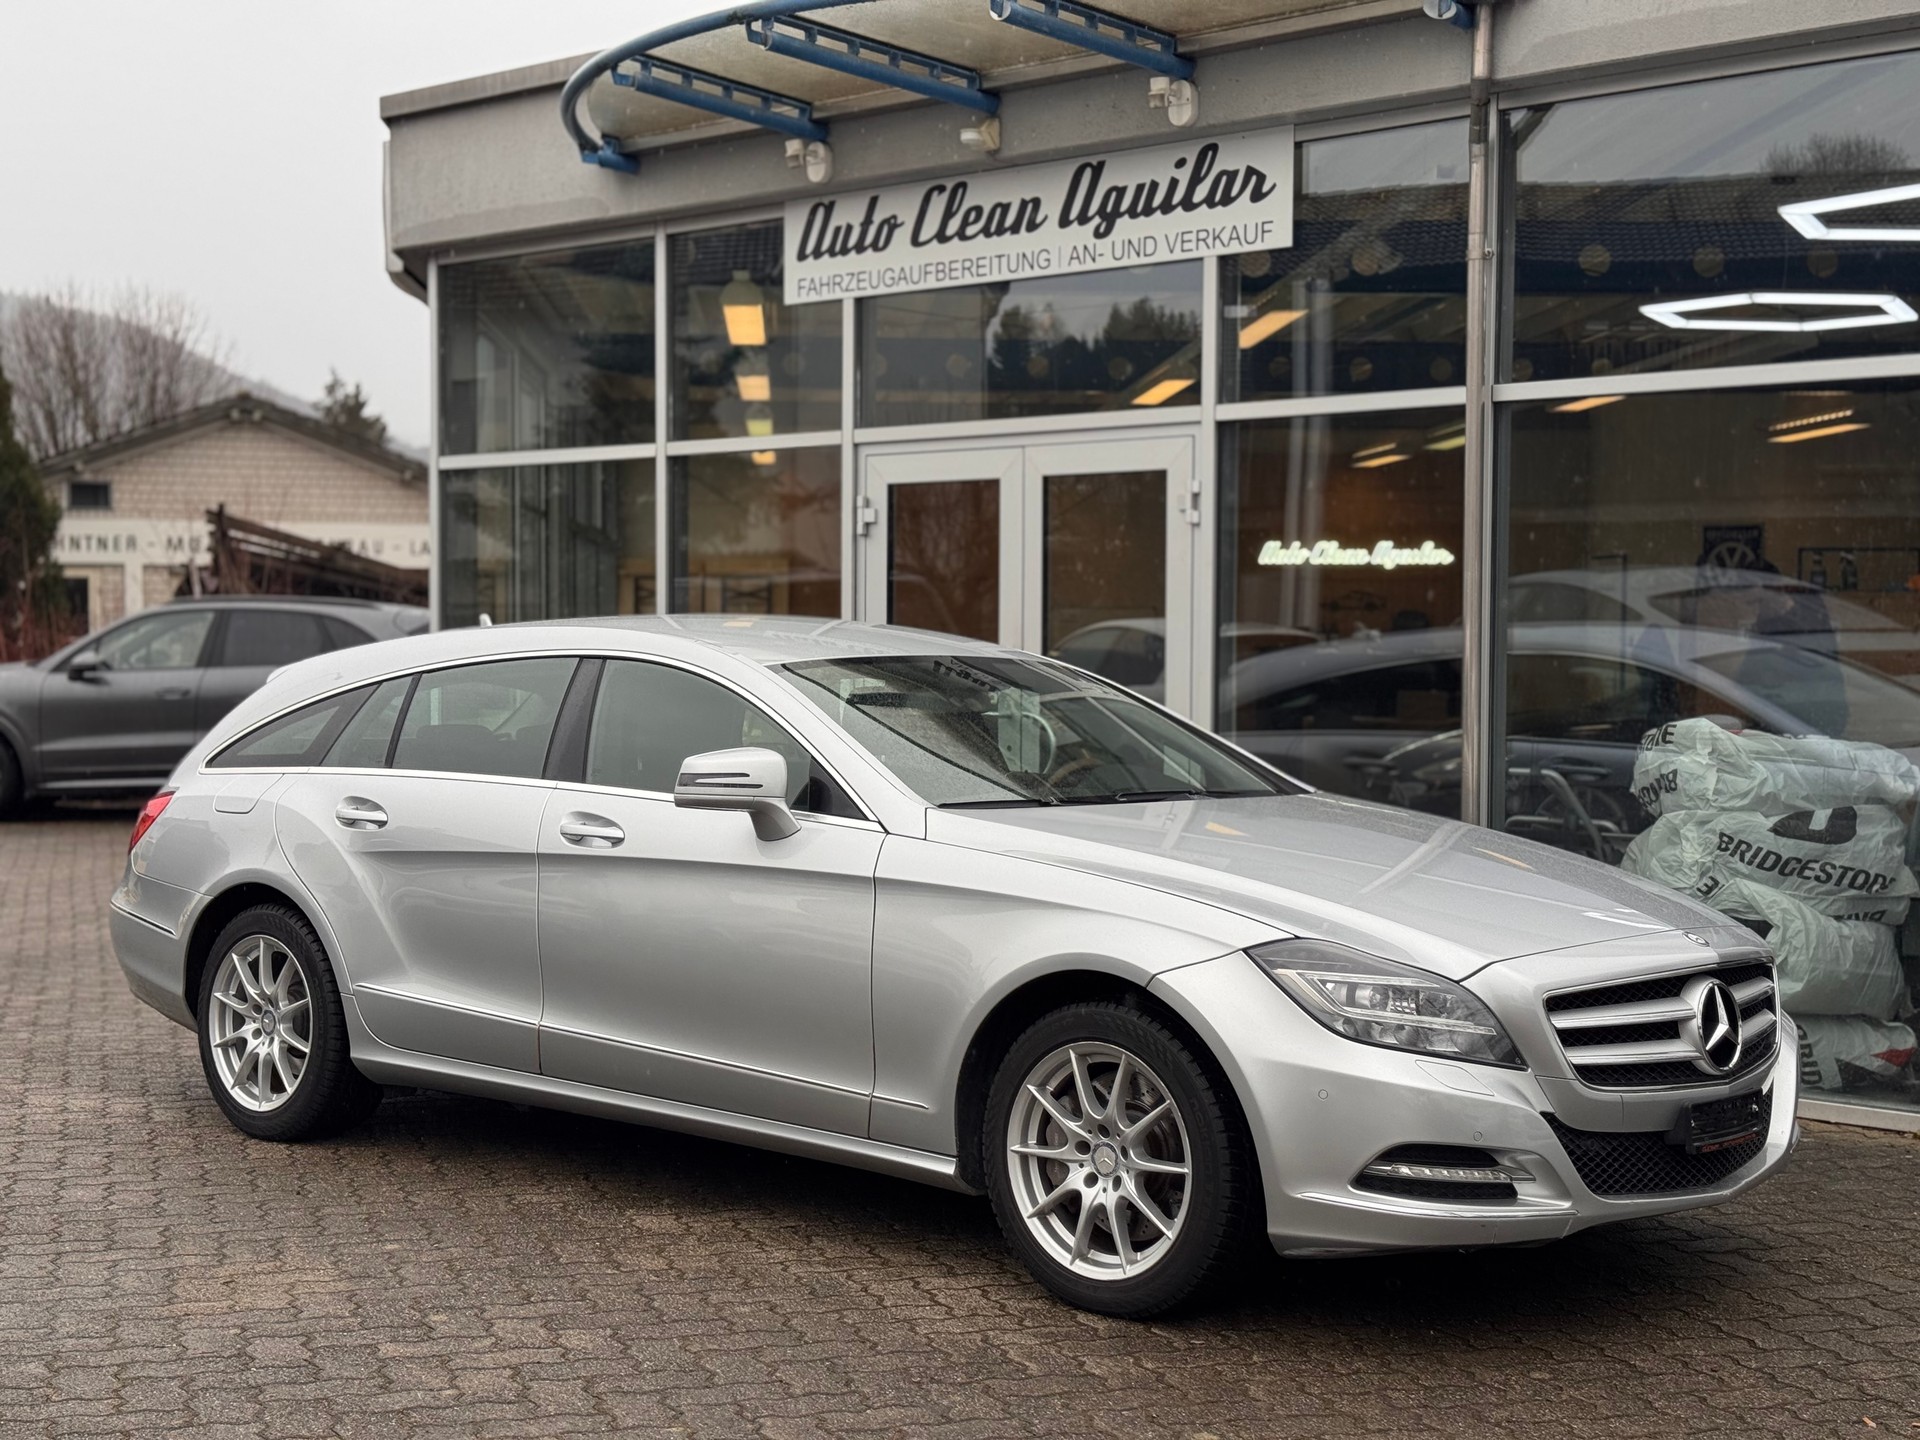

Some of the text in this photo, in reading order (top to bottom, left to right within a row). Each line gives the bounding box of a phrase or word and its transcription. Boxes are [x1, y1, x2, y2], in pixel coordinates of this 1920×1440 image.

[797, 142, 1277, 262] Auto Clean Aguilar
[797, 248, 1051, 298] FAHRZEUGAUFBEREITUNG
[1068, 245, 1105, 267] AN-
[1112, 236, 1158, 262] UND
[1164, 220, 1274, 255] VERKAUF
